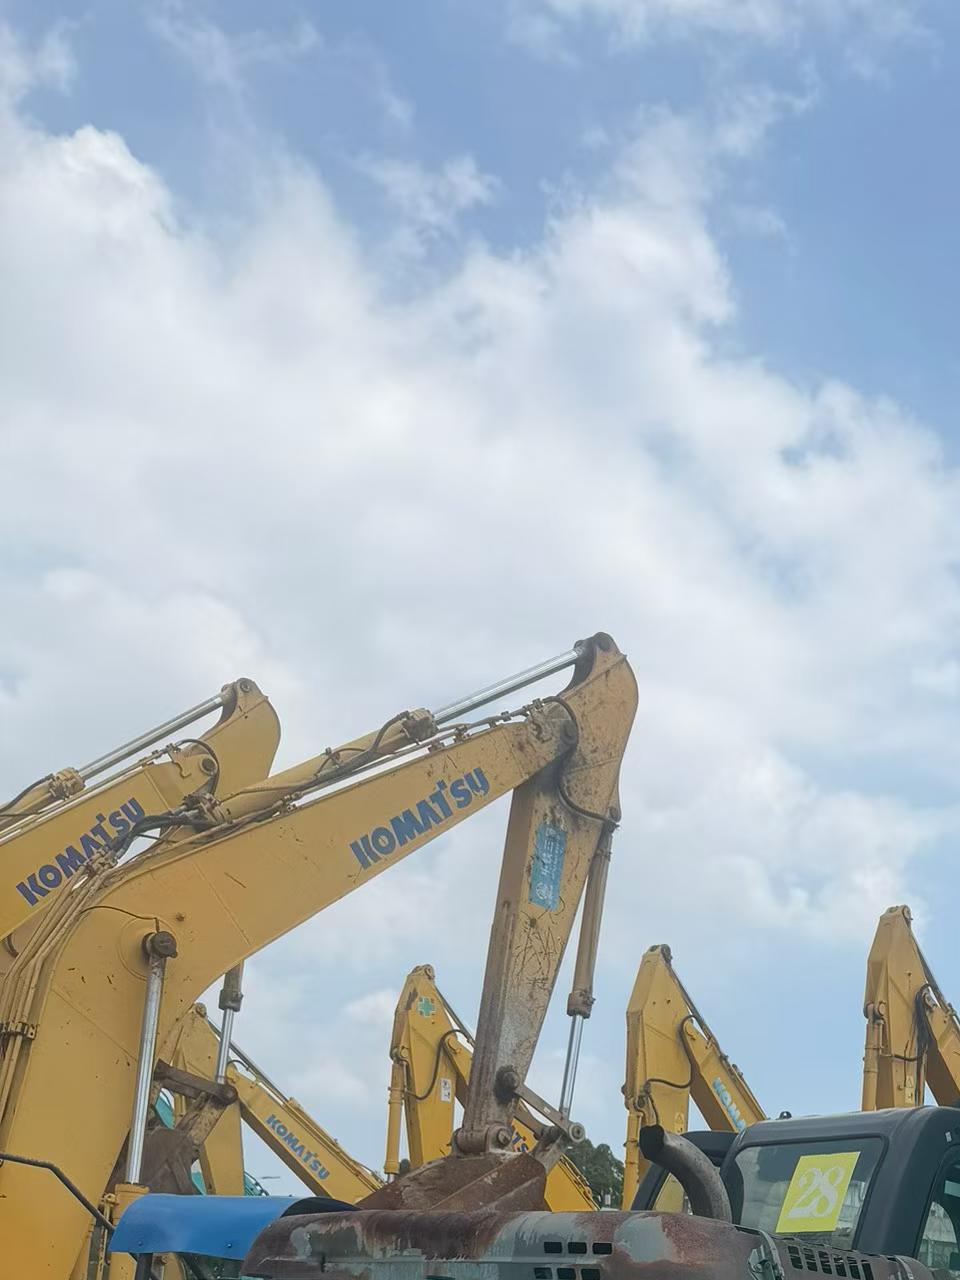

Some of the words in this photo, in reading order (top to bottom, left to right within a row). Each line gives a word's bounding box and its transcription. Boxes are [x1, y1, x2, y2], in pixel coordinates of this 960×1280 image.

[350, 767, 490, 870] KOMATSU
[266, 1113, 330, 1180] KOMATSU
[788, 1166, 845, 1218] 28
